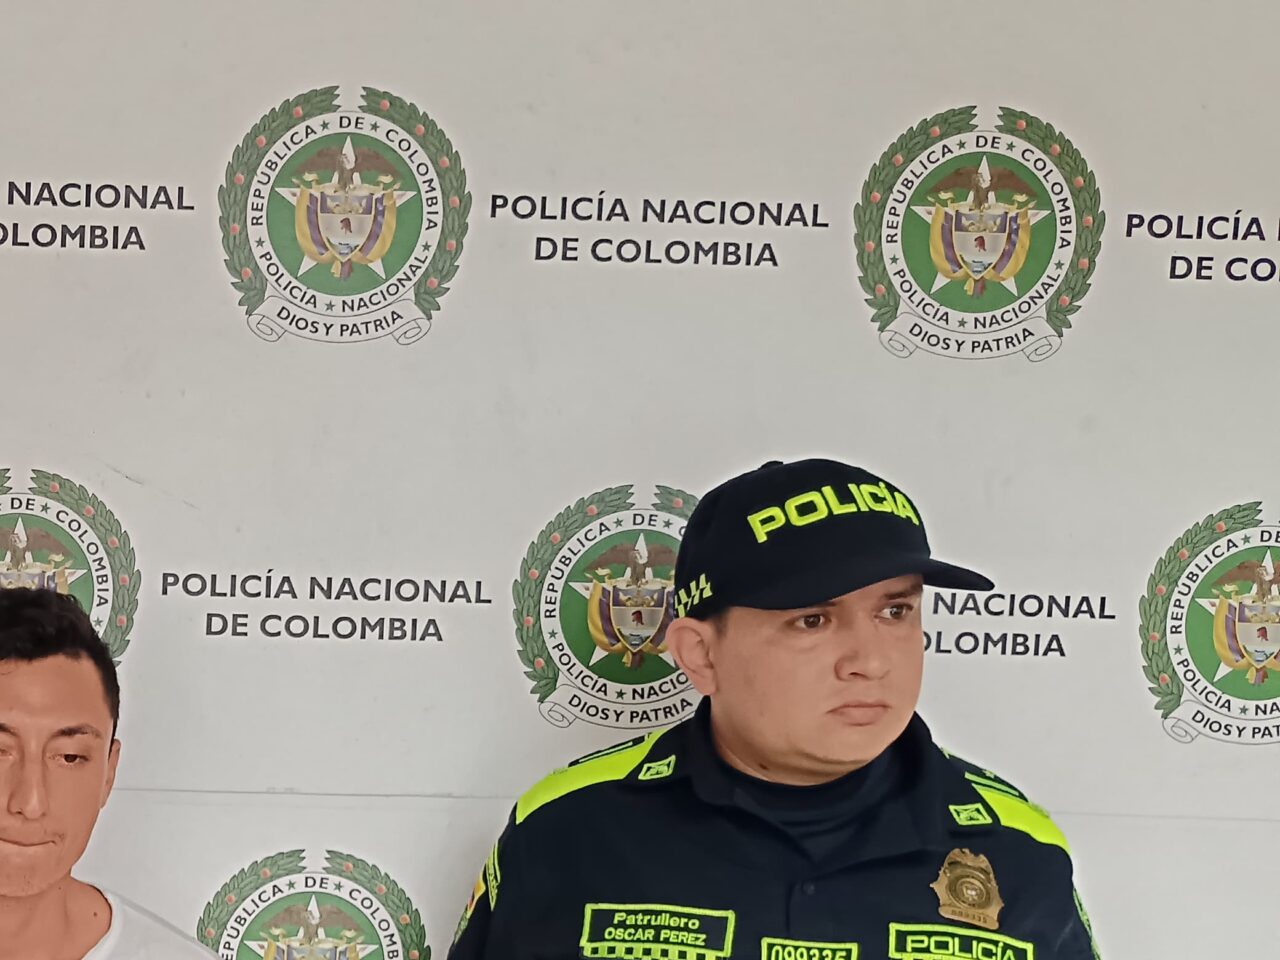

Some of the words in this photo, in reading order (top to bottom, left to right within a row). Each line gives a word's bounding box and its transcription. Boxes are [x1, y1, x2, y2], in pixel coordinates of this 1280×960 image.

[339, 116, 365, 129] DE
[385, 129, 438, 231] COLOMBIA
[7, 181, 195, 211] NACIONAL
[976, 135, 1002, 149] DE
[1021, 149, 1072, 249] COLOMBIA
[490, 190, 630, 222] POLICÍA
[641, 198, 829, 228] NACIONAL
[1125, 209, 1266, 241] POLICÍA
[534, 236, 579, 262] DE
[590, 238, 779, 267] COLOMBIA
[259, 252, 317, 308] POLICÍA
[342, 257, 428, 312] NACIONAL
[1169, 255, 1214, 281] DE
[893, 269, 949, 325] POLICÍA
[974, 275, 1061, 329] NACIONAL
[277, 306, 320, 334] DIOS
[323, 323, 334, 335] Y
[340, 310, 404, 336] PATRIA
[909, 322, 951, 350] DIOS
[955, 339, 965, 352] Y
[971, 328, 1035, 353] PATRIA
[632, 513, 658, 526] DE
[747, 481, 919, 544] POLICÍA
[10, 497, 36, 510] DE
[56, 510, 109, 607] COLOMBIA
[161, 568, 298, 600] POLICÍA
[309, 576, 493, 604] NACIONAL
[932, 592, 1116, 620] NACIONAL
[205, 612, 249, 637] DE
[259, 614, 444, 642] COLOMBIA
[923, 631, 1066, 657] LOMBIA
[552, 643, 608, 696] POLICÍA
[632, 671, 689, 700] NACIO
[1177, 659, 1231, 712] POLICÍA
[568, 694, 610, 720] DIOS
[613, 710, 624, 722] Y
[630, 698, 693, 723] PATRIA
[1192, 710, 1233, 736] DIOS
[1236, 726, 1246, 738] Y
[304, 876, 329, 889] DE
[604, 927, 654, 942] OSCAR
[660, 930, 707, 946] PEREZ
[613, 912, 700, 930] Patrullero
